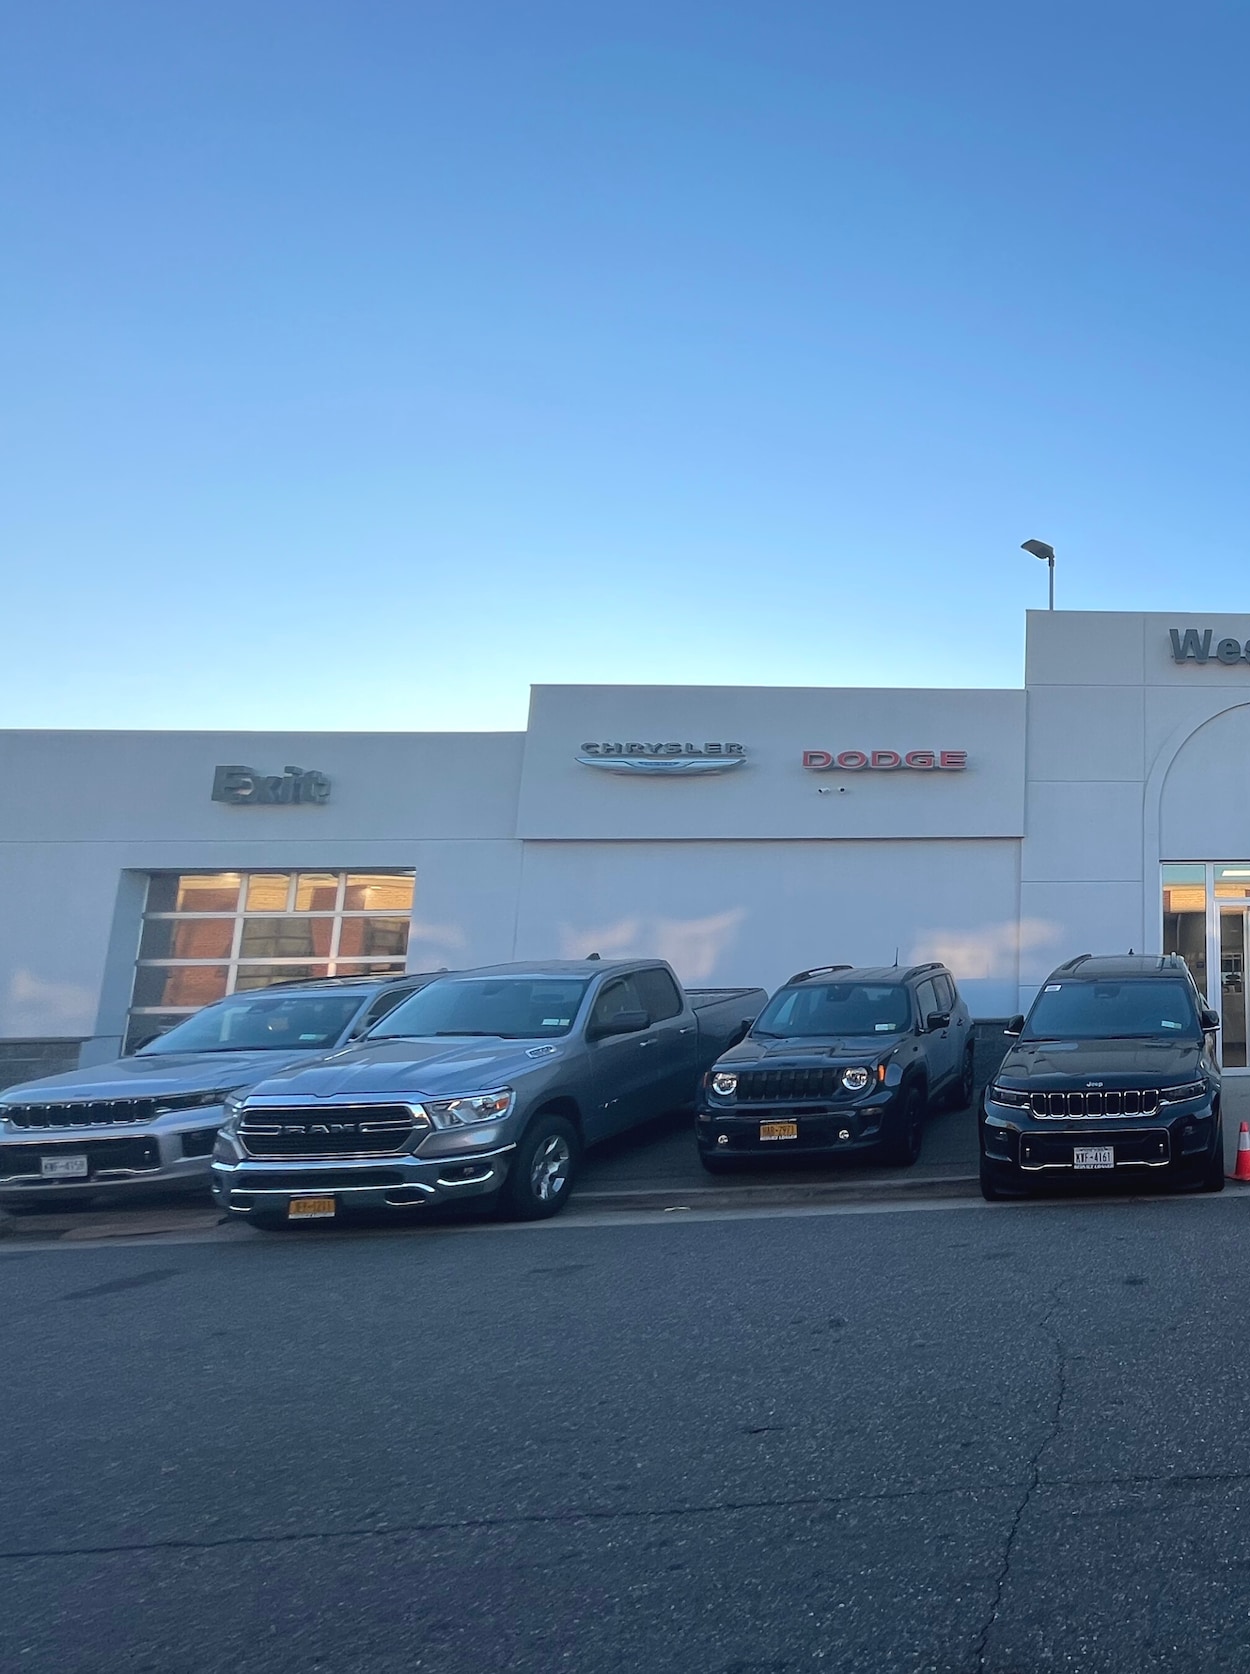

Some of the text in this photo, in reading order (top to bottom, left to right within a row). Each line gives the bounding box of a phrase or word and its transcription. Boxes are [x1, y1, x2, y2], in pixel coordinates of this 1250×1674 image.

[580, 741, 746, 756] CHRYSLER
[802, 750, 968, 770] DODGE
[211, 765, 332, 805] Exit
